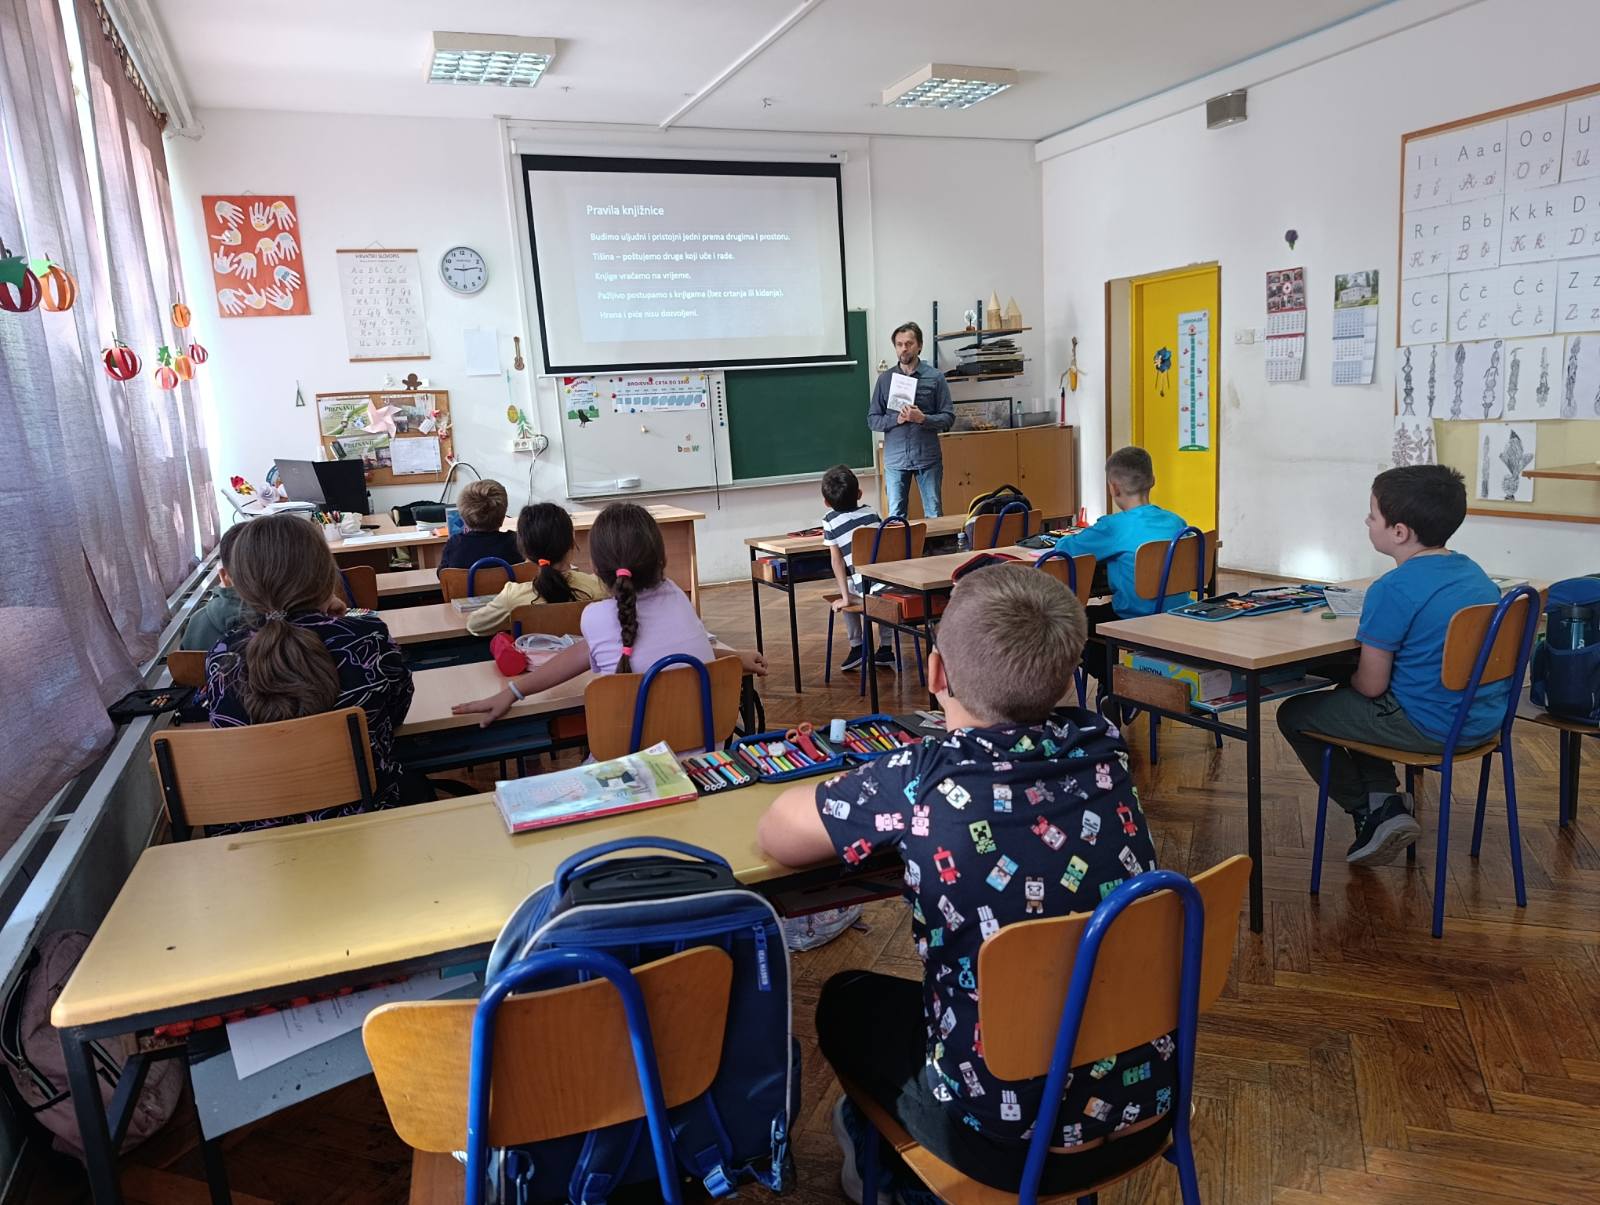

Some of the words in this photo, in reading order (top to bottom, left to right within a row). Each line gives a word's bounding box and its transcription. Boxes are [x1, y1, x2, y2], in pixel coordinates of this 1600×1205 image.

[586, 204, 620, 216] Pravila
[622, 204, 664, 218] knjižnice
[702, 234, 724, 242] prema
[726, 233, 754, 242] drugima
